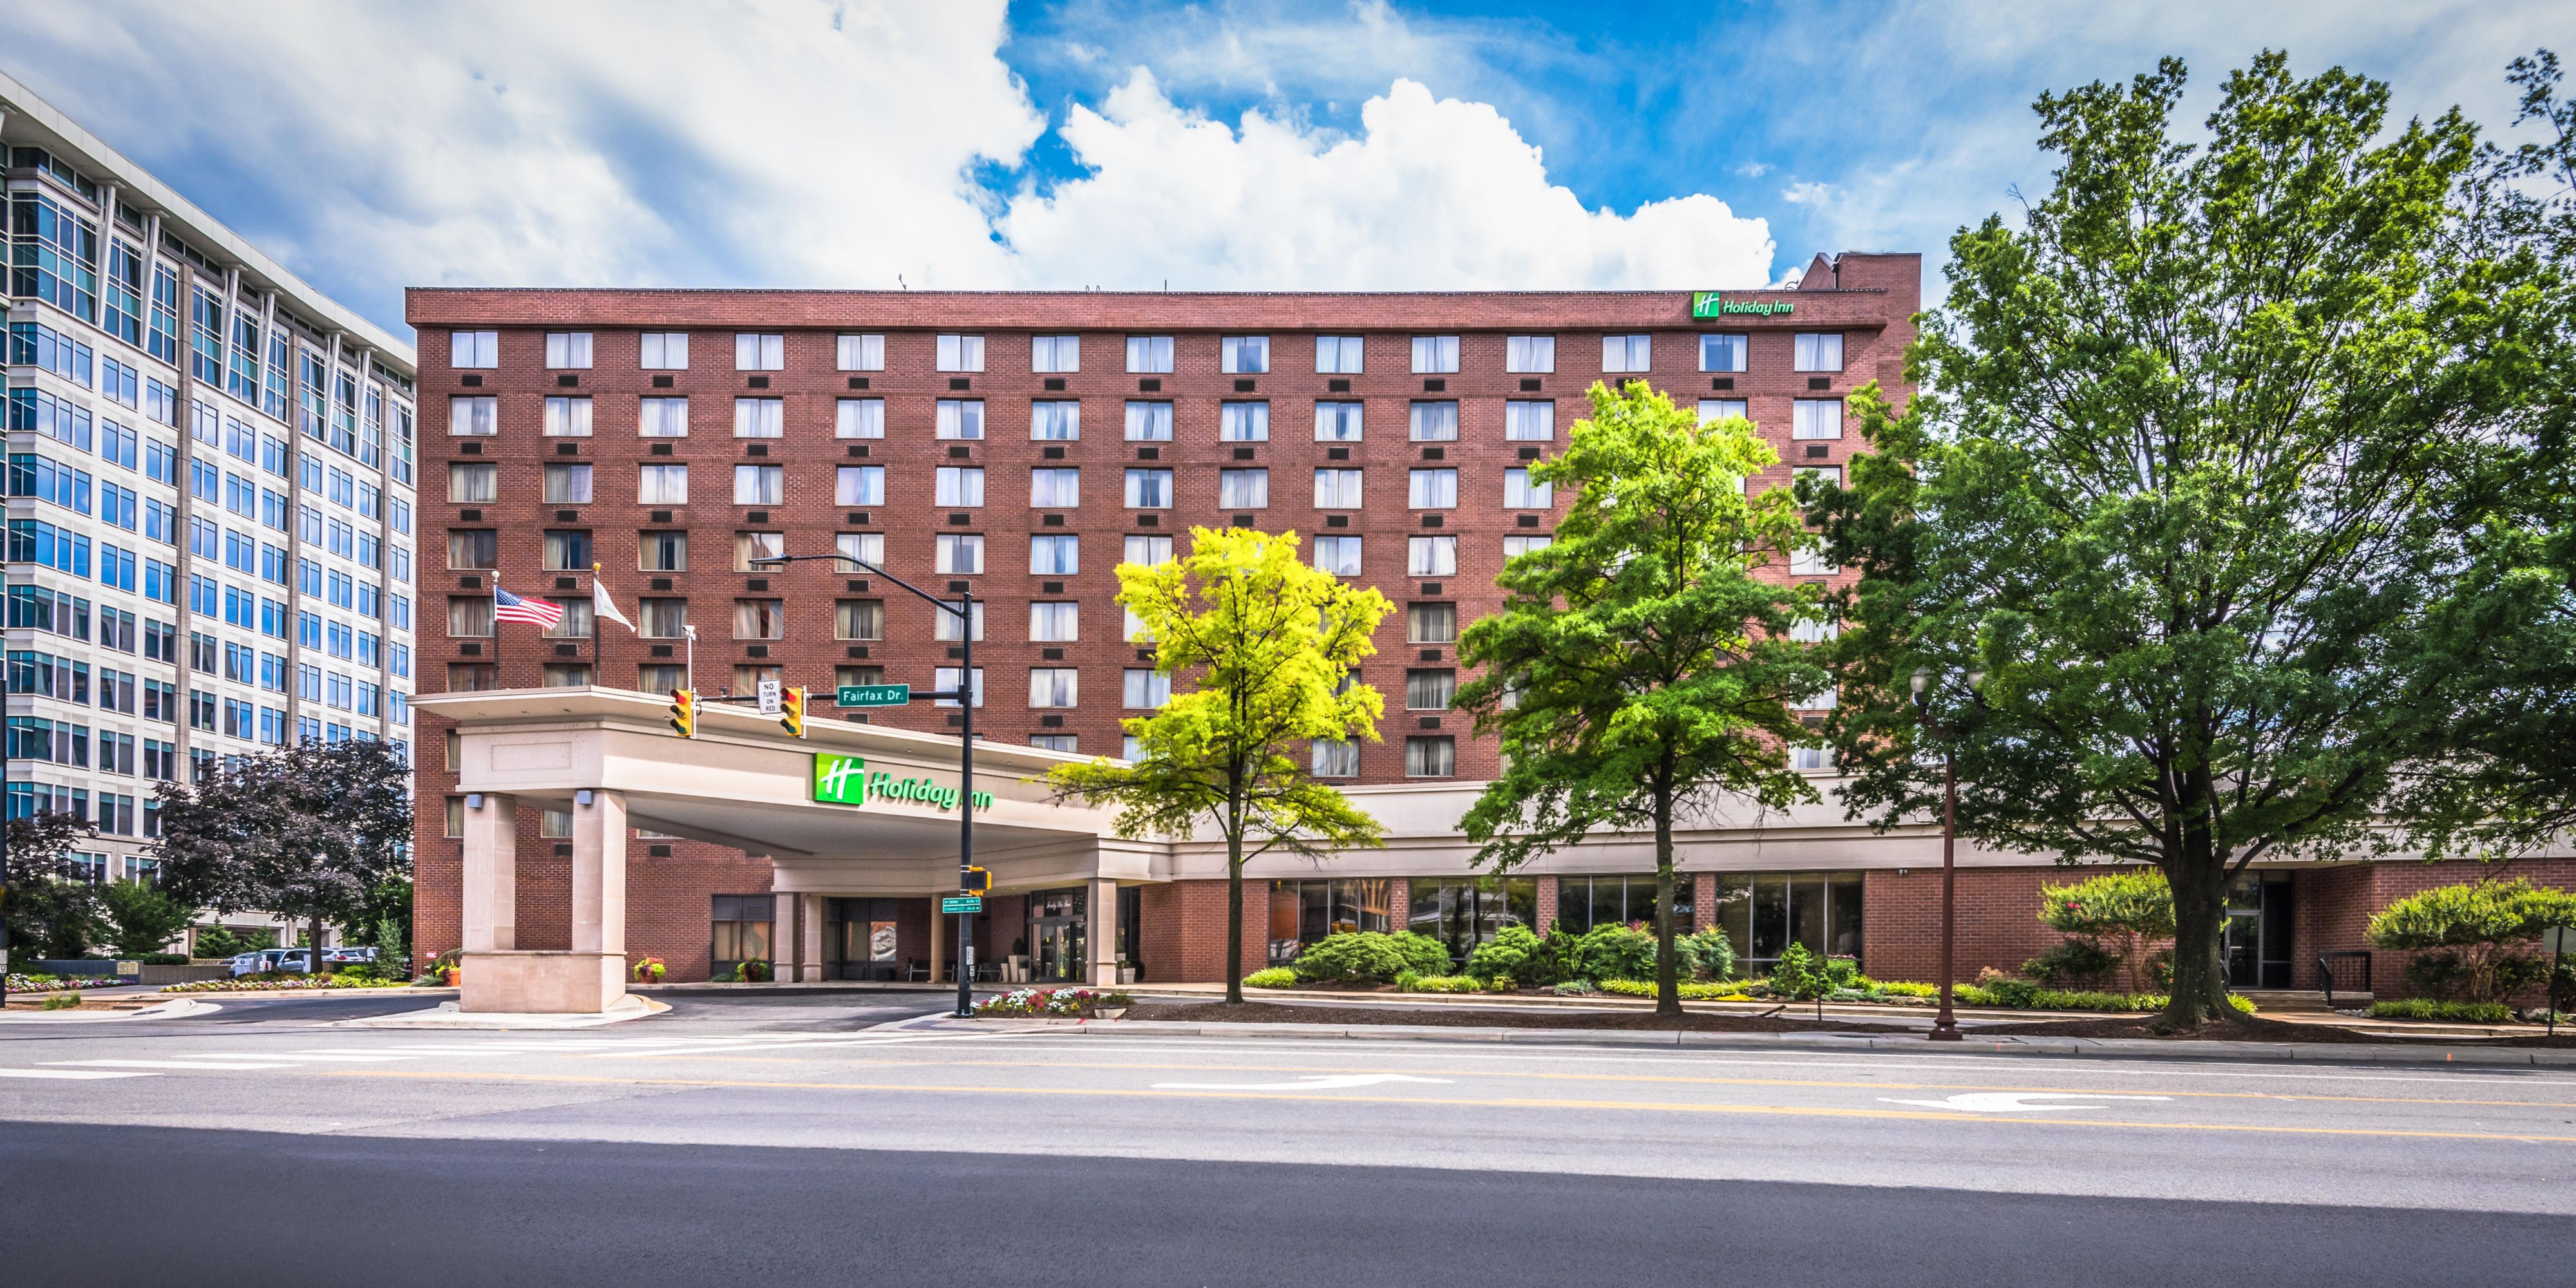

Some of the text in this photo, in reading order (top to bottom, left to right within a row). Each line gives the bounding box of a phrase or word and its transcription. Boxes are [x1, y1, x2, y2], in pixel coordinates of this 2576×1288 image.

[1723, 299, 1794, 316] Holiday Inn
[844, 690, 904, 701] Fairfax Dr.
[870, 772, 994, 809] Holiday nn
